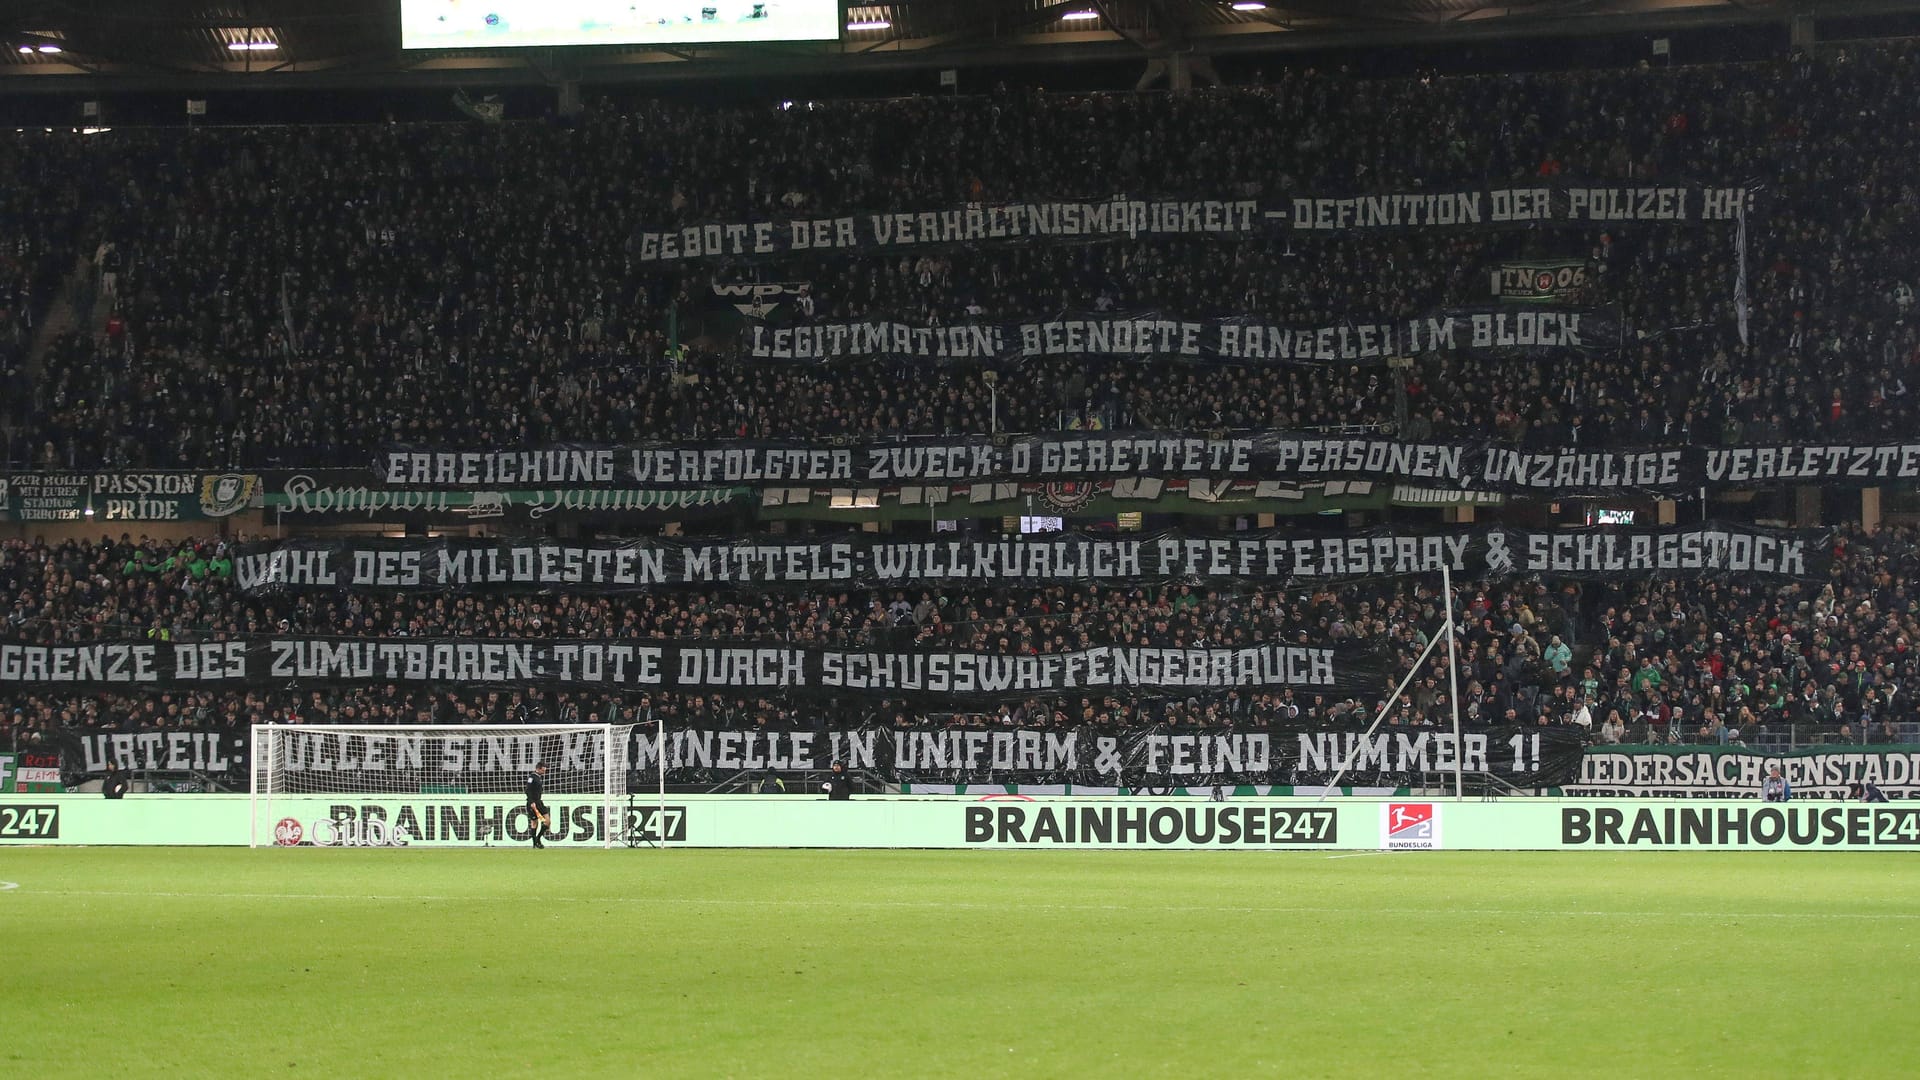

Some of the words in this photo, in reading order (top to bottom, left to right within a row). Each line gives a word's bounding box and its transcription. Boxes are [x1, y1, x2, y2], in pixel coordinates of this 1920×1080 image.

[641, 221, 774, 261] GEBOTE
[791, 217, 857, 249] DER
[1293, 192, 1482, 230] DEFINITION
[1491, 188, 1552, 221] DER
[1568, 188, 1687, 220] POLIZEI
[752, 322, 1004, 359] LEGITIMATION:
[1020, 319, 1200, 356] BEENDETE
[1218, 324, 1393, 361] RANGELEI
[1409, 317, 1457, 352] IM
[1472, 312, 1582, 348] BLOCK
[11, 475, 41, 486] ZUR
[94, 473, 198, 495] PASSION
[387, 450, 615, 484] ERREICHUNG
[631, 449, 852, 482] VERFOLGTER
[868, 446, 1002, 480] ZWECK:
[1041, 439, 1252, 474] GERETTETE
[1276, 439, 1472, 489] PERSONEN,
[1484, 444, 1682, 487] UNZÄHLIGE
[1706, 445, 1920, 481] VERLETZTE
[20, 486, 40, 497] MIT
[42, 486, 79, 497] EUREN
[106, 495, 179, 520] PRIDE
[20, 508, 80, 520] VERBOTEN!
[236, 550, 336, 592] WAHL
[353, 550, 421, 586] DES
[438, 547, 668, 586] MILDESTEN
[682, 543, 865, 582] MITTELS:
[873, 535, 1141, 580] WILLKÜRLICH
[1158, 534, 1470, 576] PFEFFERSPRAY
[1485, 532, 1513, 573] &
[1527, 532, 1805, 576] SCHLAGSTOCK
[0, 644, 159, 682] GRENZE
[174, 641, 247, 680] DES
[271, 640, 546, 681] ZUMUTBAREN:
[553, 644, 662, 685] TOTE
[678, 646, 806, 687] DURCH
[822, 646, 1335, 693] SCHUSSWAFFENGEBRAUCH
[81, 731, 246, 772] URTEIL:
[444, 733, 543, 772] SIND
[830, 730, 876, 767] IN
[895, 730, 1079, 770] UNIFORM
[1096, 737, 1123, 775] &
[1146, 733, 1270, 772] FEIND
[1298, 733, 1490, 773] NUMMER
[1512, 732, 1542, 772] 1!
[1561, 806, 1920, 845] BRAINHOUSE24
